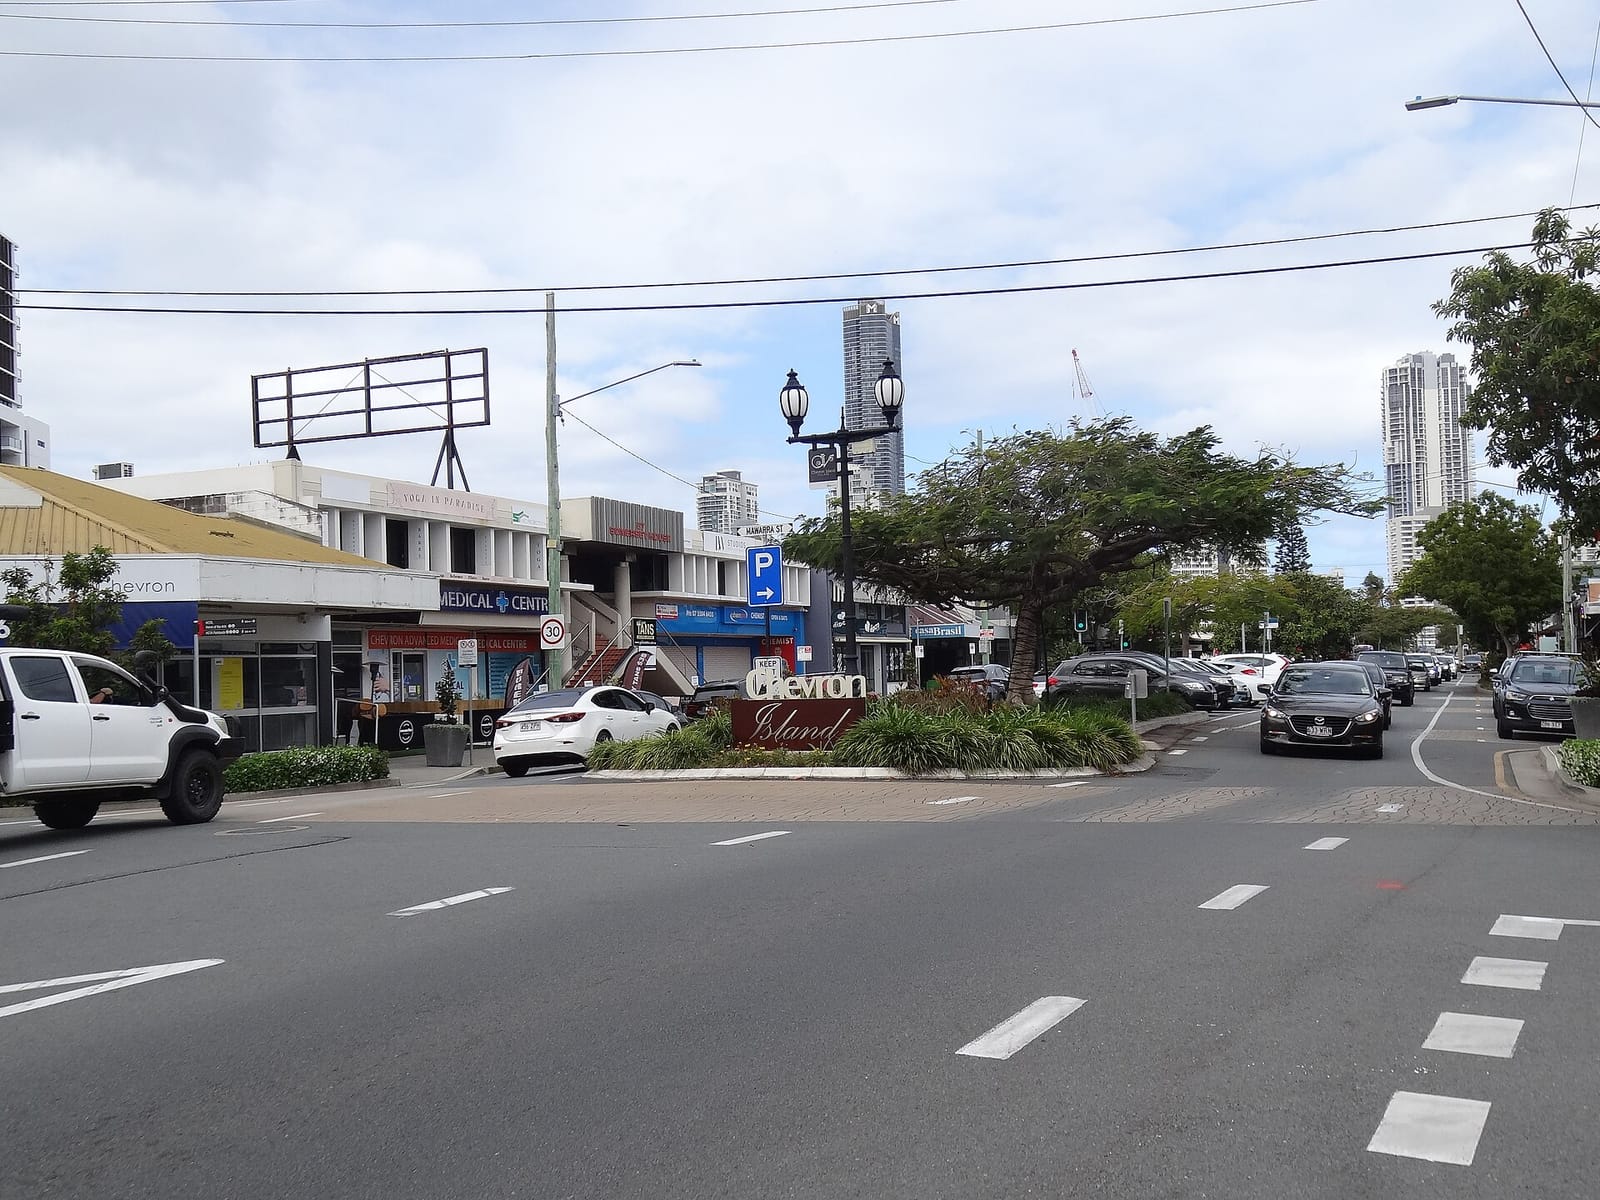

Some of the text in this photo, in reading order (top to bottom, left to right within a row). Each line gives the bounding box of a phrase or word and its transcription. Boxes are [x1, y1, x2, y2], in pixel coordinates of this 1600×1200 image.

[775, 525, 783, 533] ST
[755, 552, 773, 578] P
[111, 579, 176, 592] hevron
[440, 591, 548, 611] MEDICAL CENTR
[545, 626, 561, 637] 30
[637, 622, 655, 636] TANS
[759, 660, 777, 668] KEEP
[746, 668, 867, 698] Chevron
[749, 702, 852, 742] Island
